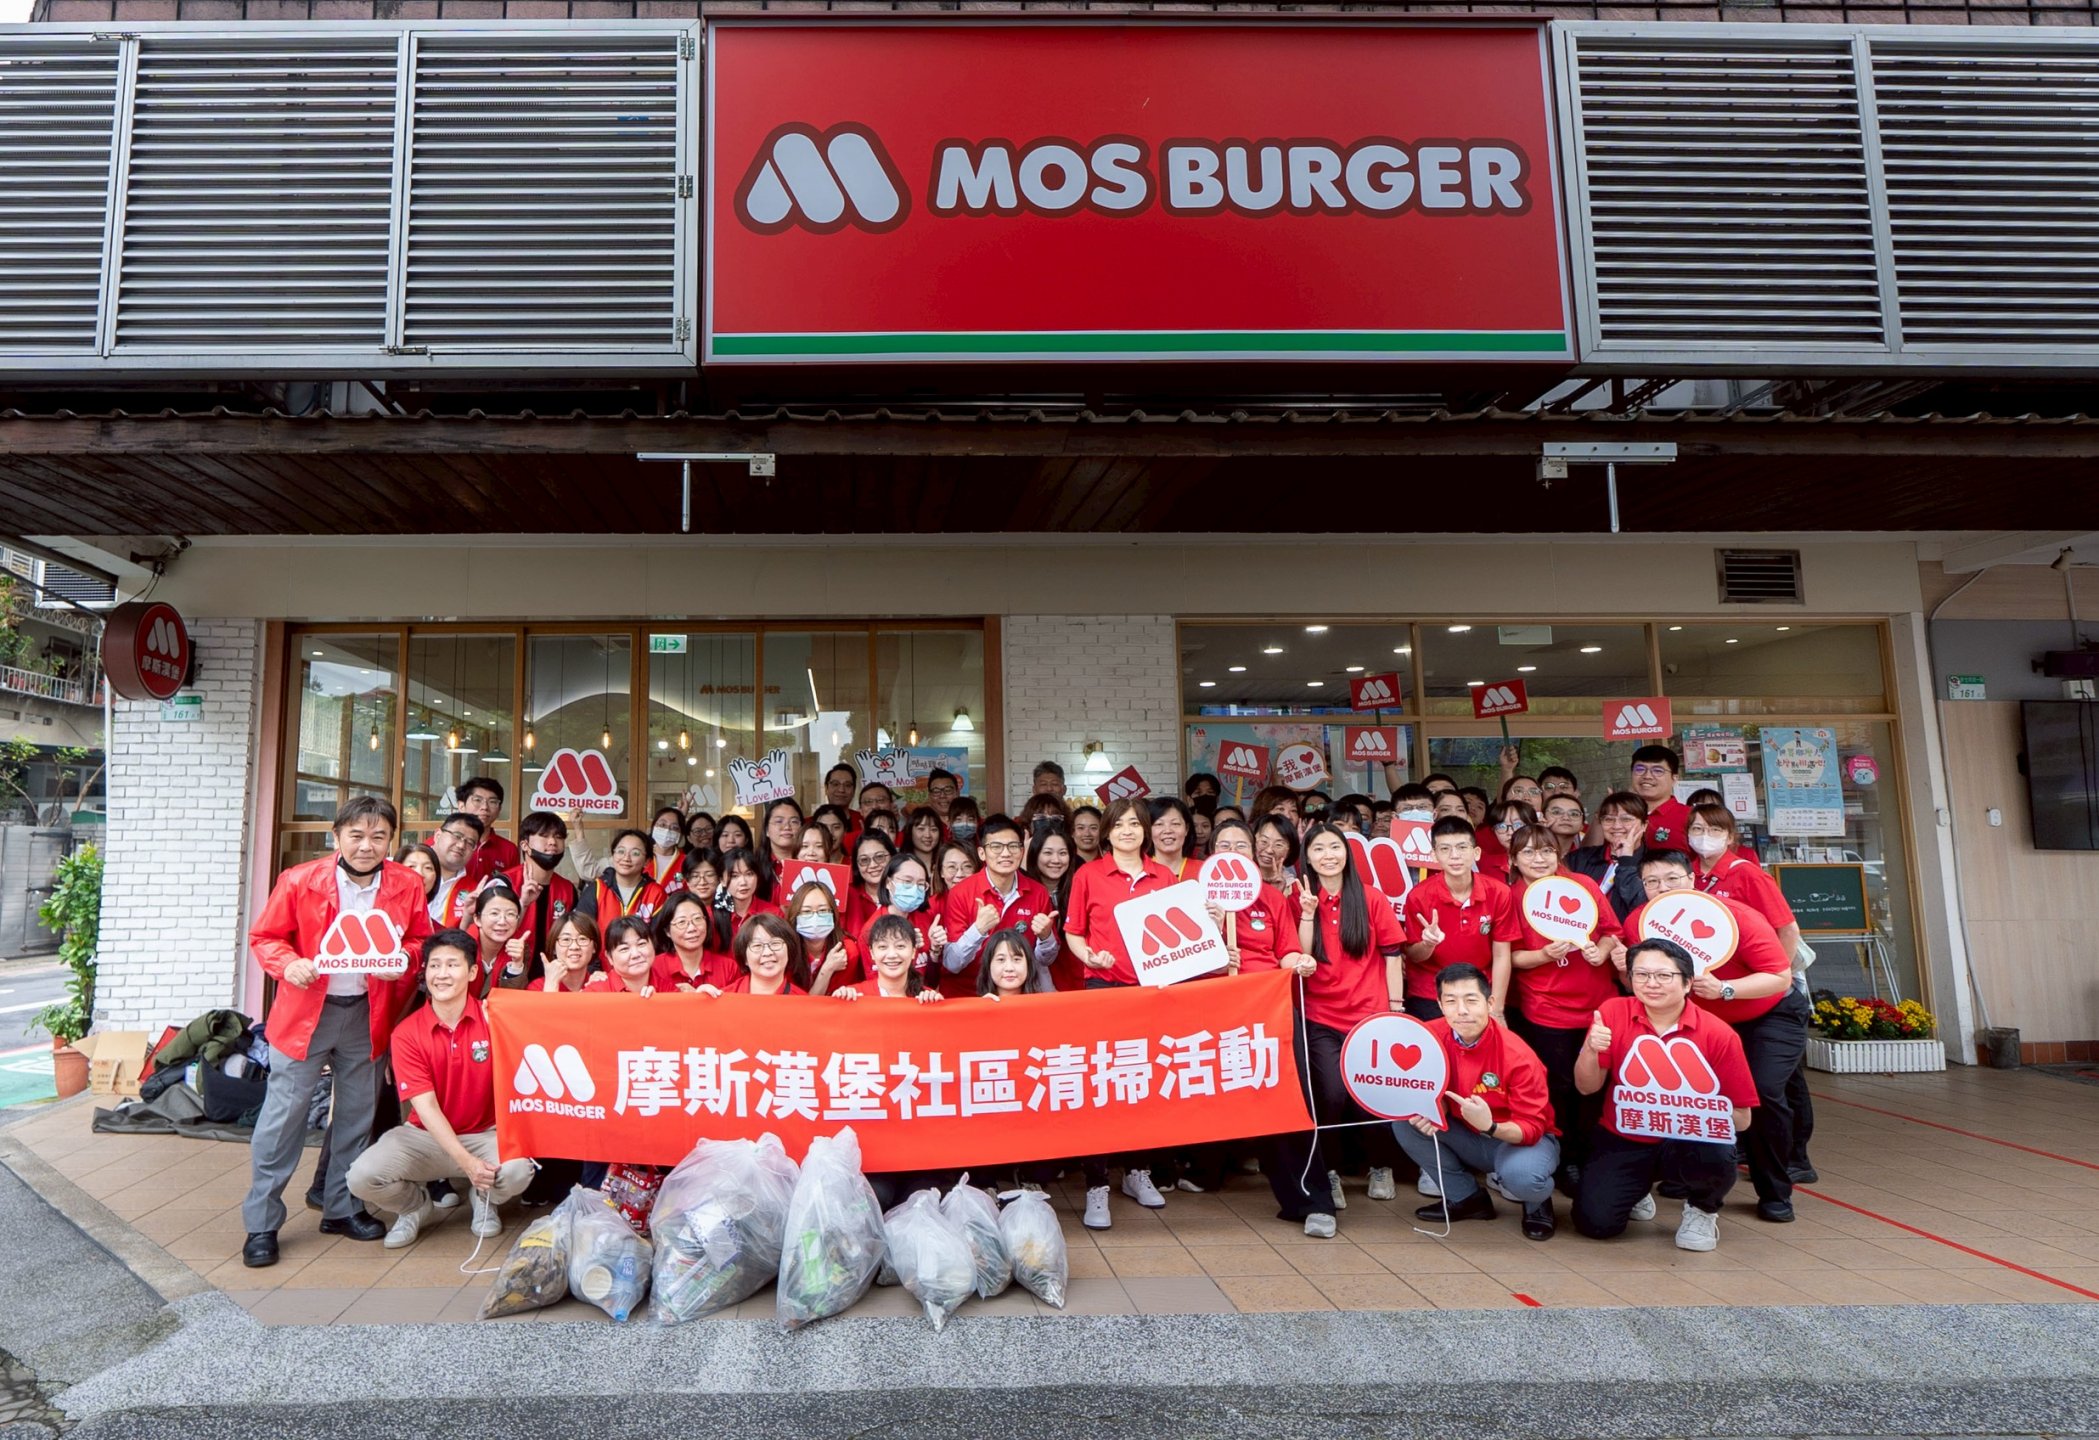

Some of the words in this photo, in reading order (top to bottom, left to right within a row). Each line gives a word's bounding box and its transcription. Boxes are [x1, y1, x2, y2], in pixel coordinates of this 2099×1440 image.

[937, 143, 1147, 210] MOS
[1168, 145, 1523, 210] BURGER
[1357, 699, 1371, 707] MOS
[1371, 697, 1396, 706] BURGER
[1960, 689, 1975, 698] 161
[174, 710, 189, 719] 161
[1480, 706, 1497, 714] MOS
[1497, 703, 1522, 713] BURGER
[1631, 726, 1663, 735] BURGER
[1223, 763, 1237, 771] MOS
[1237, 765, 1261, 775] BURGER
[1282, 759, 1298, 774] 我
[896, 777, 916, 786] Mos
[535, 796, 567, 808] MOS
[568, 797, 619, 810] BURGER
[736, 795, 743, 807] I
[744, 790, 770, 805] Love
[773, 786, 795, 799] Mos
[1207, 889, 1253, 901] 摩斯漢堡
[1544, 890, 1552, 909] I
[1531, 909, 1552, 921] MOS
[1553, 915, 1588, 930] BURGER
[1670, 908, 1686, 925] I
[1648, 919, 1673, 938] MOS
[1671, 934, 1713, 963] BURGER
[318, 958, 350, 969] MOS
[351, 957, 403, 968] BURGER
[1142, 954, 1169, 971] MOS
[1170, 938, 1216, 961] BURGER
[1371, 1039, 1378, 1068] I
[614, 1022, 1280, 1121] 摩斯漢堡社區清掃活動
[1354, 1073, 1383, 1086] MOS
[1385, 1076, 1435, 1091] BURGER
[509, 1097, 544, 1114] MOS
[545, 1099, 606, 1120] BURGER
[1618, 1089, 1658, 1104] MOS
[1660, 1093, 1728, 1112] BURGER
[1620, 1107, 1732, 1141] 摩斯漢堡
